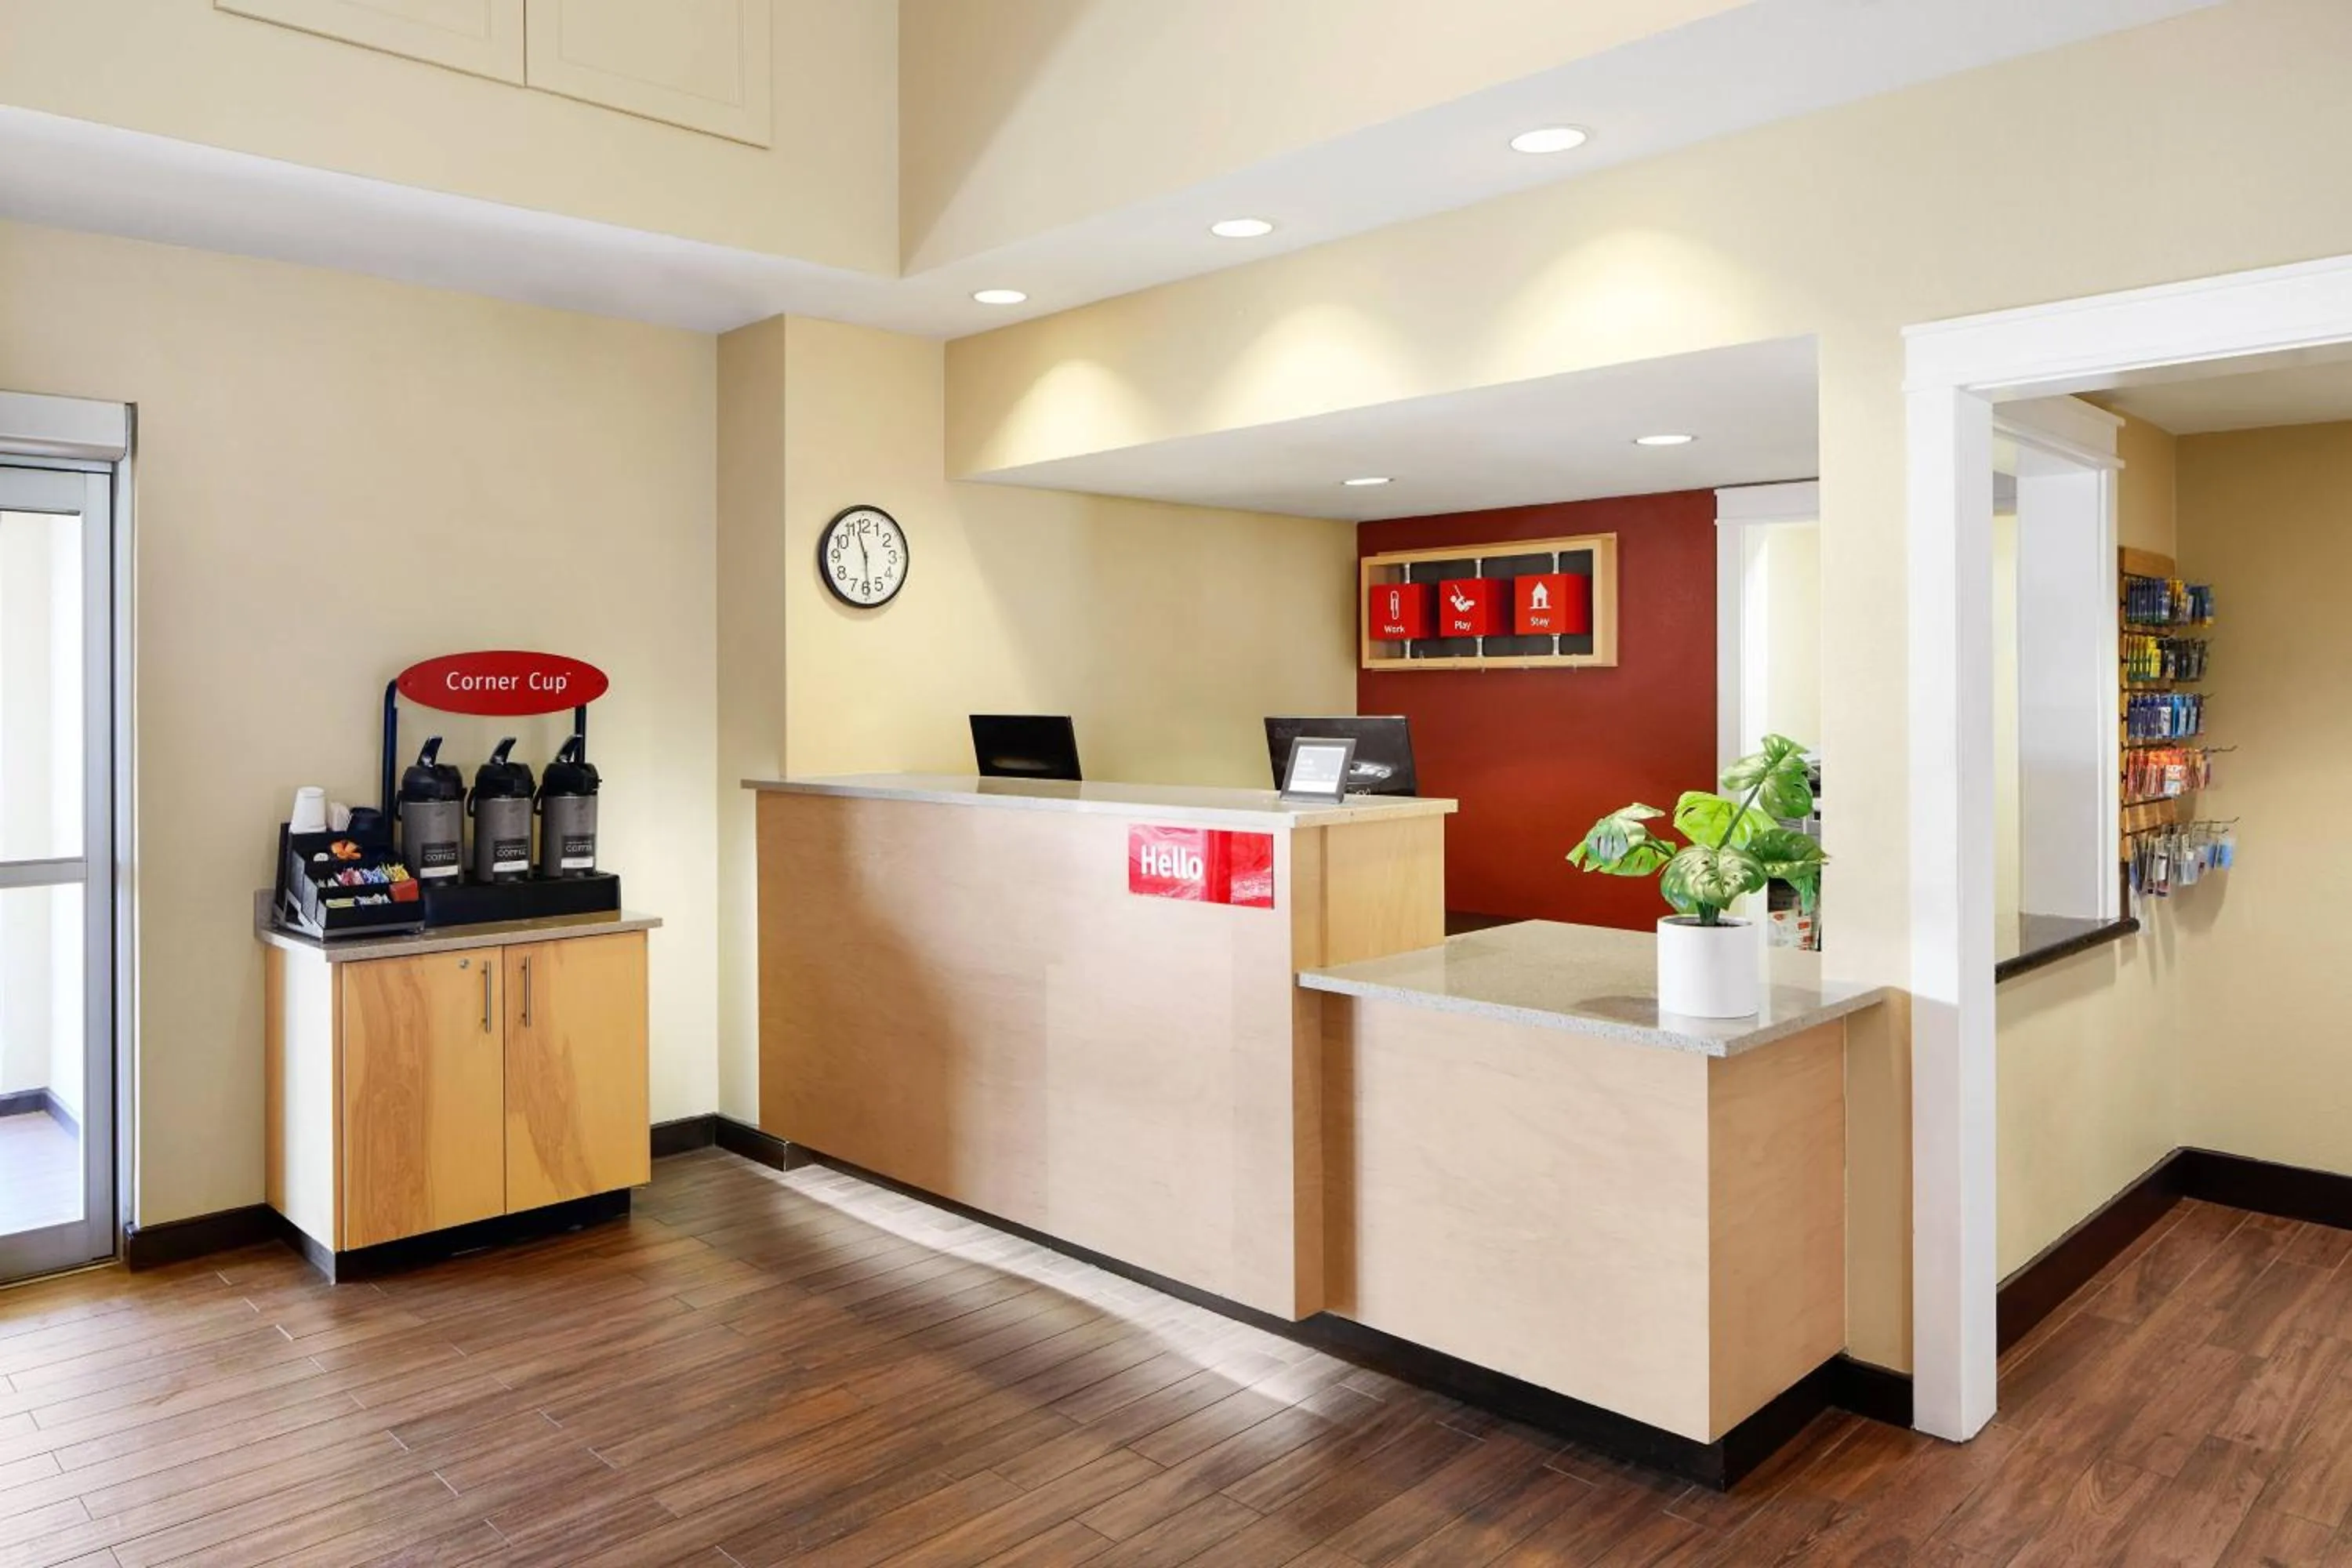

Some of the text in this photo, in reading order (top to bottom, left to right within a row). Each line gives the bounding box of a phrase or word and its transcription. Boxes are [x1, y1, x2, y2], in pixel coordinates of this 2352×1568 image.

[846, 521, 855, 536] 11
[856, 518, 871, 534] 12
[873, 523, 880, 536] 1
[834, 534, 849, 550] 10
[882, 533, 891, 548] 2
[831, 548, 841, 563] 9
[888, 550, 898, 564] 3
[837, 565, 848, 580] 8
[884, 566, 894, 579] 4
[849, 579, 858, 592] 7
[862, 580, 871, 596] 6
[874, 577, 884, 591] 5
[1384, 625, 1406, 633] Work
[1454, 620, 1472, 631] Play
[1530, 617, 1550, 628] Stay
[446, 671, 519, 691] Corner
[1140, 844, 1203, 880] Hello
